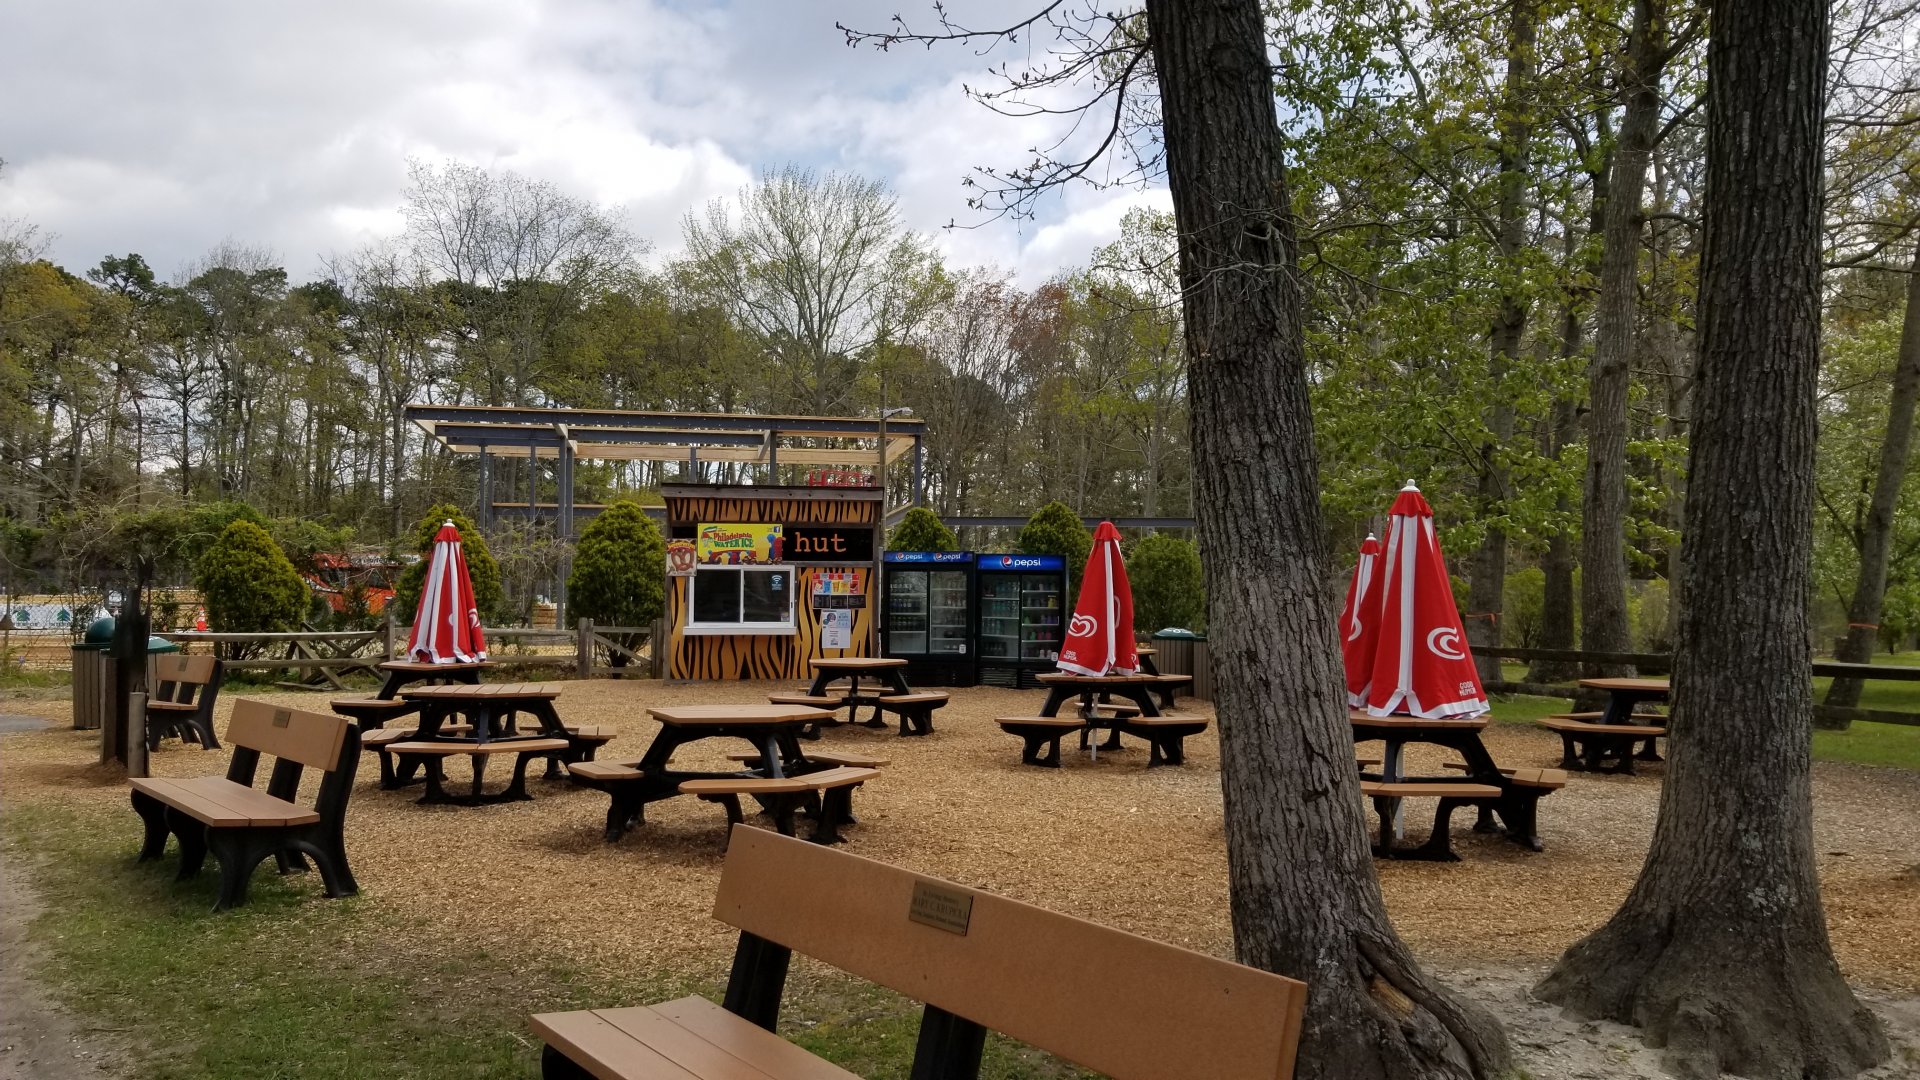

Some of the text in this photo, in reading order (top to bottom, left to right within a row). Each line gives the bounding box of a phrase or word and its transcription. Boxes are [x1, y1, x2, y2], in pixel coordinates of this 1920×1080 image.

[713, 532, 753, 542] Philadelphia
[794, 531, 847, 553] hut
[714, 538, 754, 548] WATER ICE
[1014, 558, 1041, 567] pepsi
